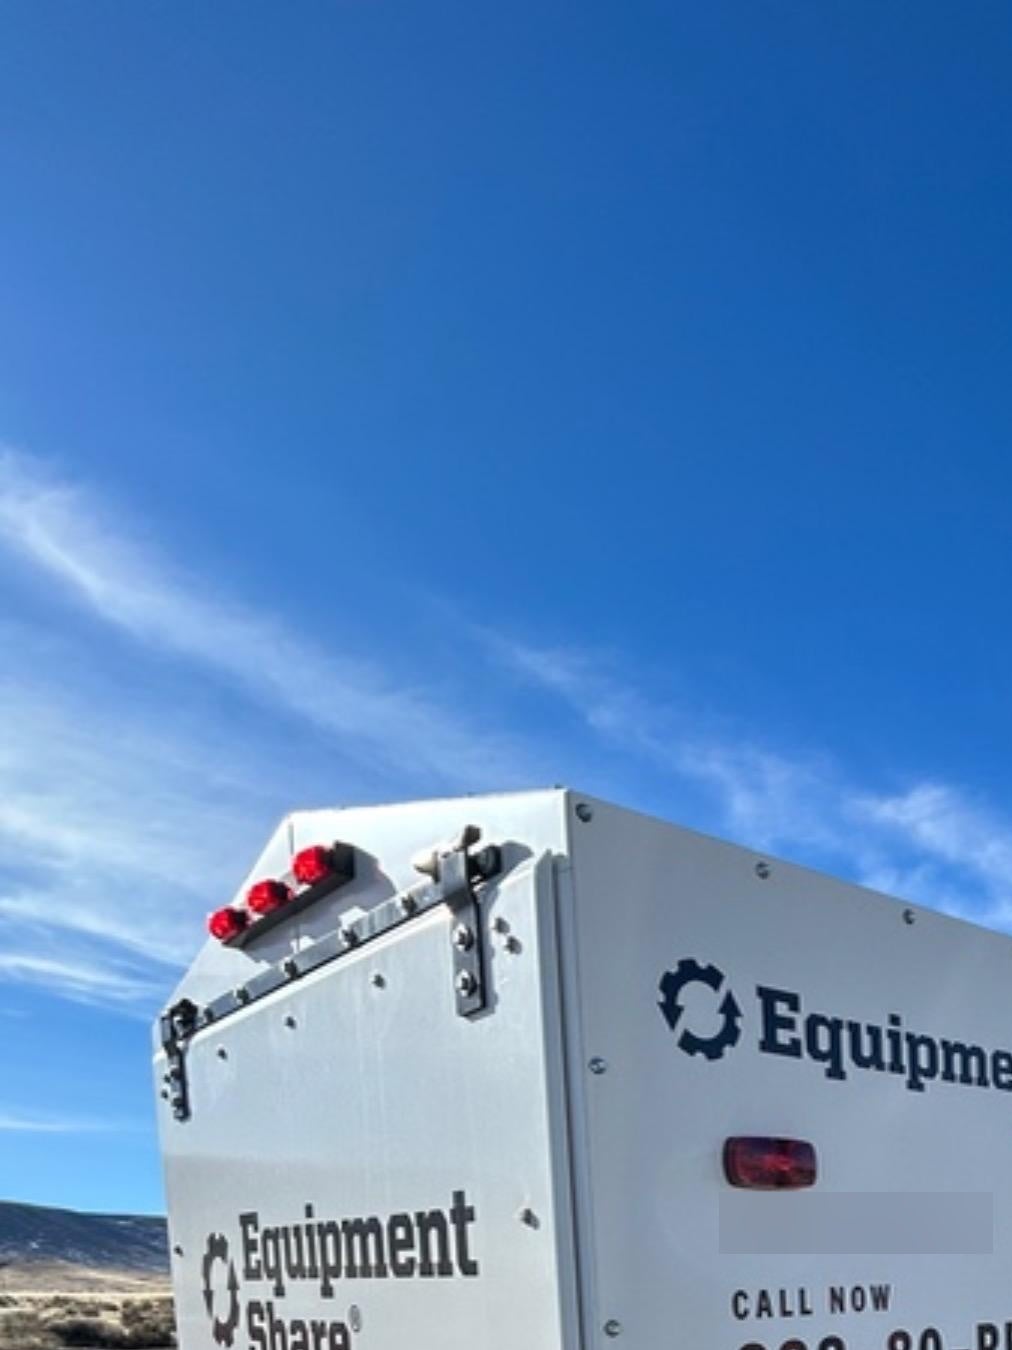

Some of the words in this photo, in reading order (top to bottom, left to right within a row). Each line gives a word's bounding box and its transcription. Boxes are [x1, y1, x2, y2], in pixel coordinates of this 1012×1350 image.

[239, 1190, 479, 1298] Equipment
[731, 1287, 813, 1321] CALL
[829, 1283, 892, 1313] NOW
